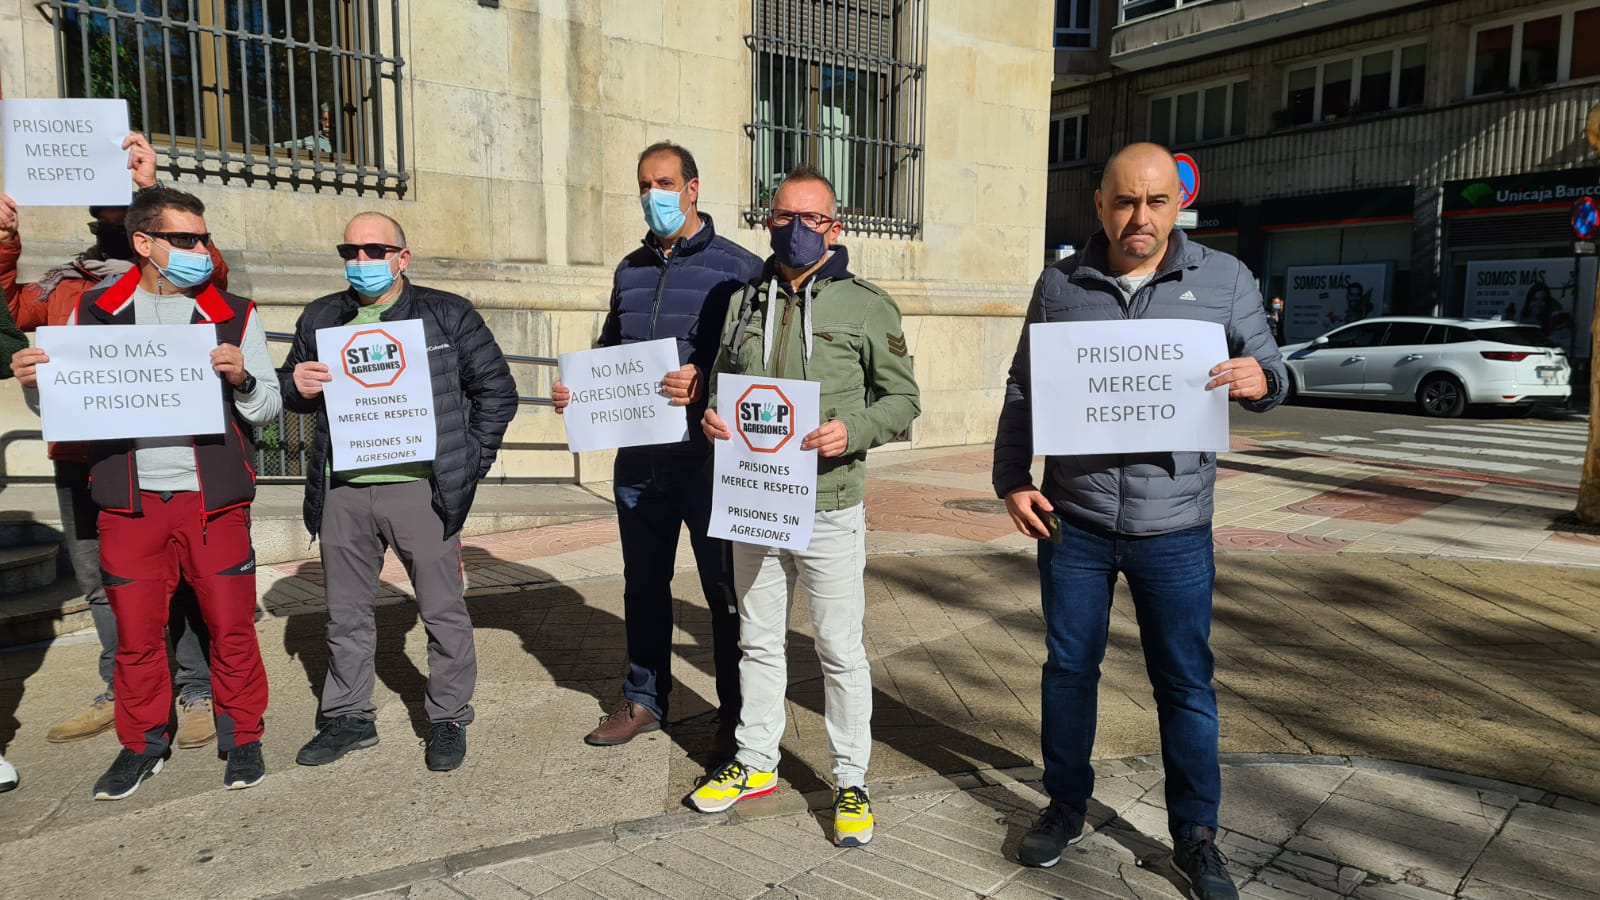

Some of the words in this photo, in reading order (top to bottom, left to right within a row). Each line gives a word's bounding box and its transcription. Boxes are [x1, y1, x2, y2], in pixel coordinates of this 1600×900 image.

[13, 119, 94, 134] PRISIONES
[25, 143, 89, 157] MERECE
[27, 167, 95, 181] RESPETO
[1496, 187, 1553, 203] Unicaja
[1555, 184, 1600, 198] Banco
[1197, 218, 1219, 228] anco
[1293, 275, 1327, 290] SOMOS
[1328, 272, 1351, 289] MÁS
[1477, 270, 1517, 286] SOMOS
[1520, 267, 1546, 285] MÁS
[89, 344, 119, 359] NO
[125, 340, 167, 358] MÁS
[346, 343, 398, 365] STP
[1077, 343, 1184, 364] PRISIONES
[54, 368, 174, 385] AGRESIONES
[180, 367, 204, 382] EN
[351, 360, 401, 375] AGRESIONES
[591, 364, 611, 379] NO
[615, 358, 644, 376] MÁS
[570, 382, 650, 404] AGRESIONES
[1088, 374, 1173, 394] MERECE
[83, 392, 181, 410] PRISIONES
[355, 394, 408, 407] PRISIONES
[338, 412, 379, 424] MERECE
[384, 408, 428, 420] RESPETO
[590, 405, 656, 424] PRISIONES
[740, 401, 789, 423] STP
[1086, 404, 1176, 423] RESPETO
[743, 423, 789, 435] AGRESIONES
[349, 436, 401, 449] PRISIONES
[406, 435, 422, 445] SIN
[355, 449, 417, 464] AGRESIONES
[738, 460, 790, 476] PRISIONES
[721, 475, 759, 490] MERECE
[763, 481, 809, 496] RESPETO
[728, 506, 778, 523] PRISIONES
[782, 513, 800, 526] SIN
[730, 524, 791, 542] AGRESIONES
